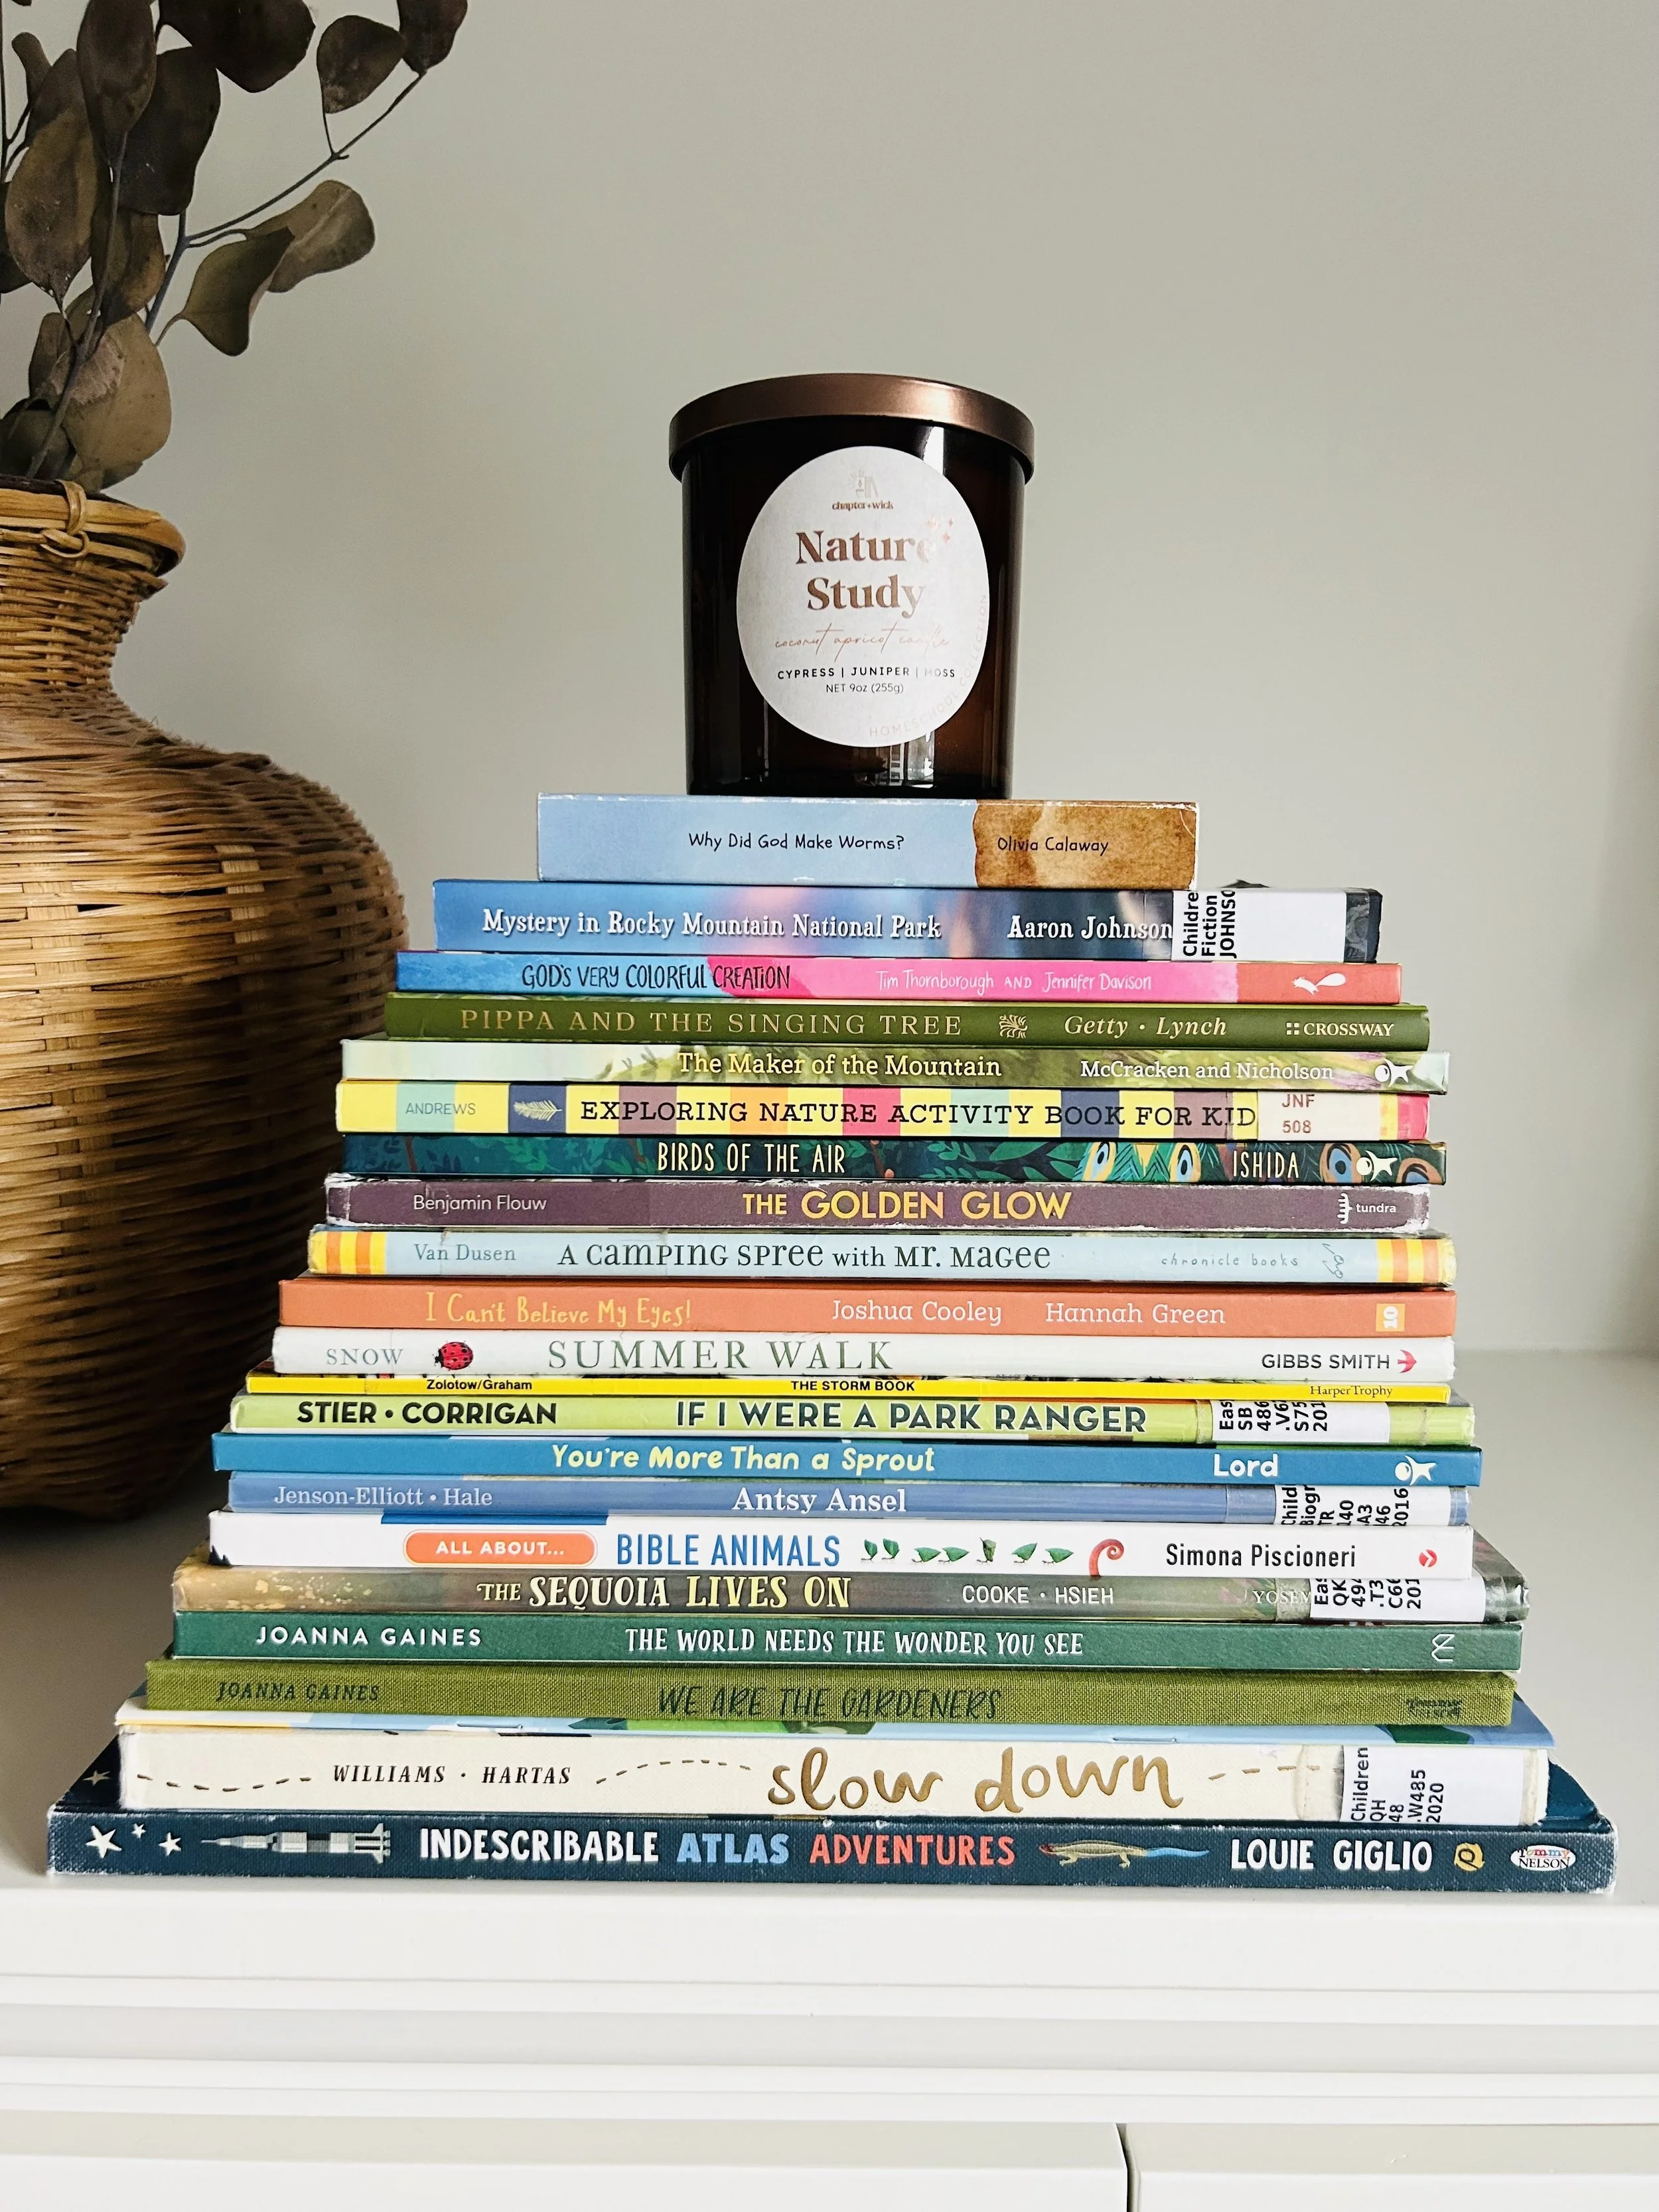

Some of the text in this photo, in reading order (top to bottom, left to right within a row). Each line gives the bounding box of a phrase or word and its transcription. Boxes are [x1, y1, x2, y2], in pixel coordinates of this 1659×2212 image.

[831, 500, 893, 511] chapter+wick
[796, 530, 937, 565] Nature
[807, 574, 924, 618] Study
[775, 623, 843, 654] coconut
[834, 622, 908, 662] apricot
[778, 667, 955, 680] CYPRESS JUNIPER MOSS
[826, 684, 845, 693] NET
[871, 684, 904, 694] (255g)
[689, 832, 904, 851] Why Did God Make Worms?
[997, 836, 1109, 856] Olivia Calaway
[482, 909, 941, 938] Mystery in Rocky Mountain National Park
[1007, 915, 1173, 940] Aaron Johnson
[1201, 895, 1217, 956] Fiction
[875, 970, 1151, 995] Tim Thornborough AND Jennifer Davison
[461, 1009, 962, 1035] PIPPA AND THE SINGING TREE
[1064, 1015, 1226, 1039] Getty Lynch
[1303, 1022, 1395, 1037] CROSSWAY
[678, 1053, 1002, 1076] The Maker of the Mountain
[1080, 1060, 1334, 1080] McCracken and Nicholson
[405, 1102, 476, 1116] ANDREWS
[1282, 1094, 1315, 1108] JNF
[581, 1101, 747, 1121] EXPLORING
[759, 1103, 877, 1122] NATURE
[887, 1105, 1033, 1124] ACTIVITY
[1045, 1106, 1125, 1125] BOOK
[1135, 1107, 1192, 1126] FOR
[1282, 1120, 1311, 1134] 508
[658, 1142, 845, 1173] BIRDS OF THE AIR
[1233, 1151, 1299, 1179] ISHIDA
[413, 1195, 547, 1215] Benjamin Flouw
[743, 1191, 1072, 1220] THE GOLDEN GLOW
[1356, 1202, 1396, 1214] tundra
[414, 1243, 516, 1260] Van Dusen
[1161, 1253, 1297, 1266] chronicle books
[426, 1292, 691, 1327] I Can't Believe My Eyes!
[832, 1299, 1226, 1326] Joshua Cooley Hannah Green
[326, 1348, 403, 1365] SNOW
[549, 1340, 893, 1370] SUMMER WALK
[1262, 1354, 1390, 1369] GIBBS SMITH
[427, 1379, 532, 1390] Zolotow/Graham
[791, 1380, 915, 1391] THE STORM BOOK
[1310, 1385, 1392, 1398] HarperTrophy
[297, 1401, 557, 1424] STIER CORRIGAN
[1238, 1408, 1253, 1430] SB
[553, 1444, 935, 1475] You're More Than a Sprout
[1213, 1453, 1278, 1477] Lord
[274, 1486, 493, 1506] Jenson-Elliott Hale
[733, 1487, 906, 1514] Antsy Ansel
[618, 1534, 840, 1567] BIBLE ANIMALS
[1165, 1543, 1355, 1568] Simona Piscioneri
[476, 1576, 851, 1609] THE SEQUOIA LIVES ON
[962, 1585, 1114, 1605] COOKE HSIEH
[1331, 1580, 1350, 1606] QK
[255, 1626, 482, 1647] JOANNA GAINES
[626, 1628, 1084, 1656] THE WORLD NEEDS THE WONDER YOU SEE
[216, 1682, 380, 1702] JOANNA GAINES
[659, 1685, 1001, 1720] WE ARE THE GARDENERS
[333, 1764, 571, 1785] WILLIAMS HARTAS
[768, 1746, 1184, 1813] slow down
[1350, 1747, 1369, 1821] Children
[1370, 1800, 1387, 1822] QH
[1389, 1805, 1404, 1822] 48
[1426, 1783, 1444, 1823] 2020
[419, 1828, 1015, 1866] INDESCRIBABLE ATLAS ADVENTURES
[1230, 1838, 1433, 1872] LOUIE GIGLIO
[1518, 1857, 1570, 1869] NELSON
